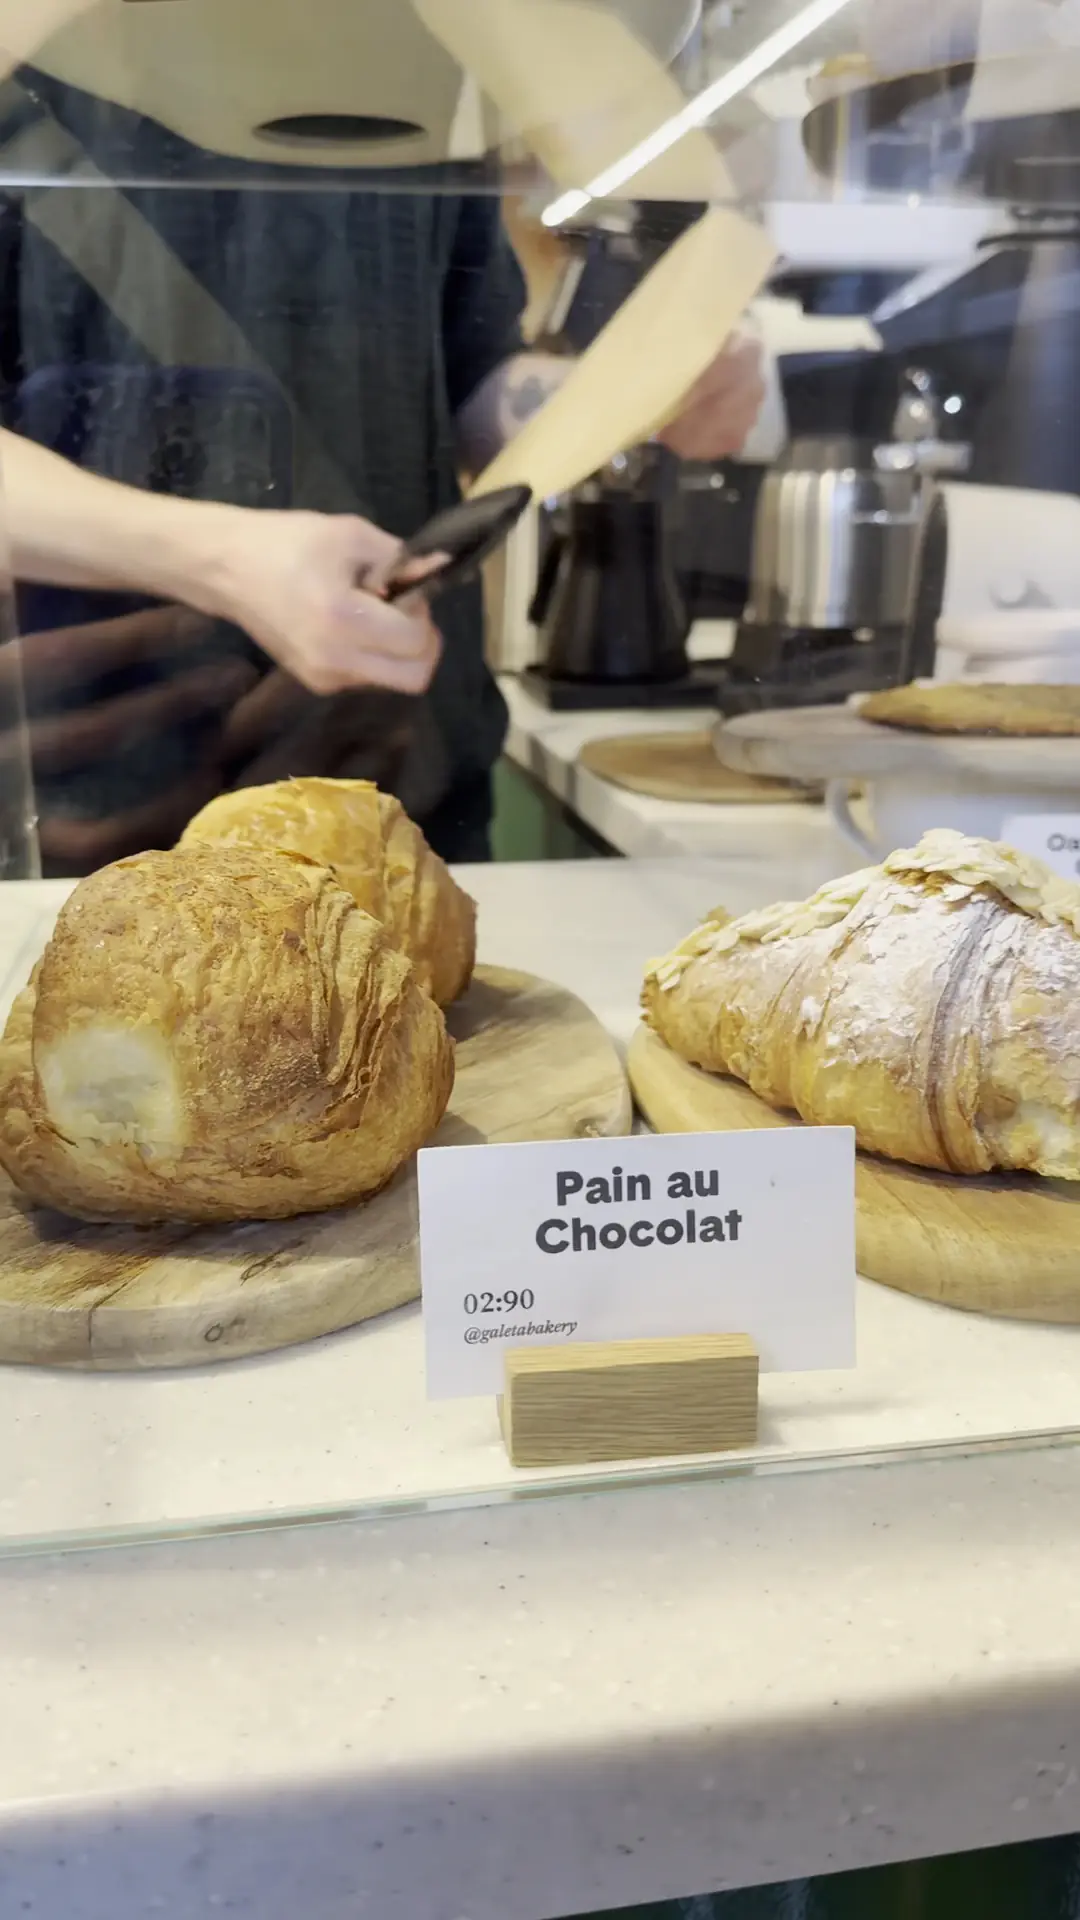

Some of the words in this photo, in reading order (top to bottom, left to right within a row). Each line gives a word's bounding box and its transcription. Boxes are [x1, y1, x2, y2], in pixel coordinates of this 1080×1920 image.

[556, 1166, 651, 1207] Pain
[667, 1169, 720, 1199] au
[535, 1209, 743, 1254] Chocolat
[463, 1288, 535, 1315] 02:90
[463, 1319, 578, 1345] @galetabakery
